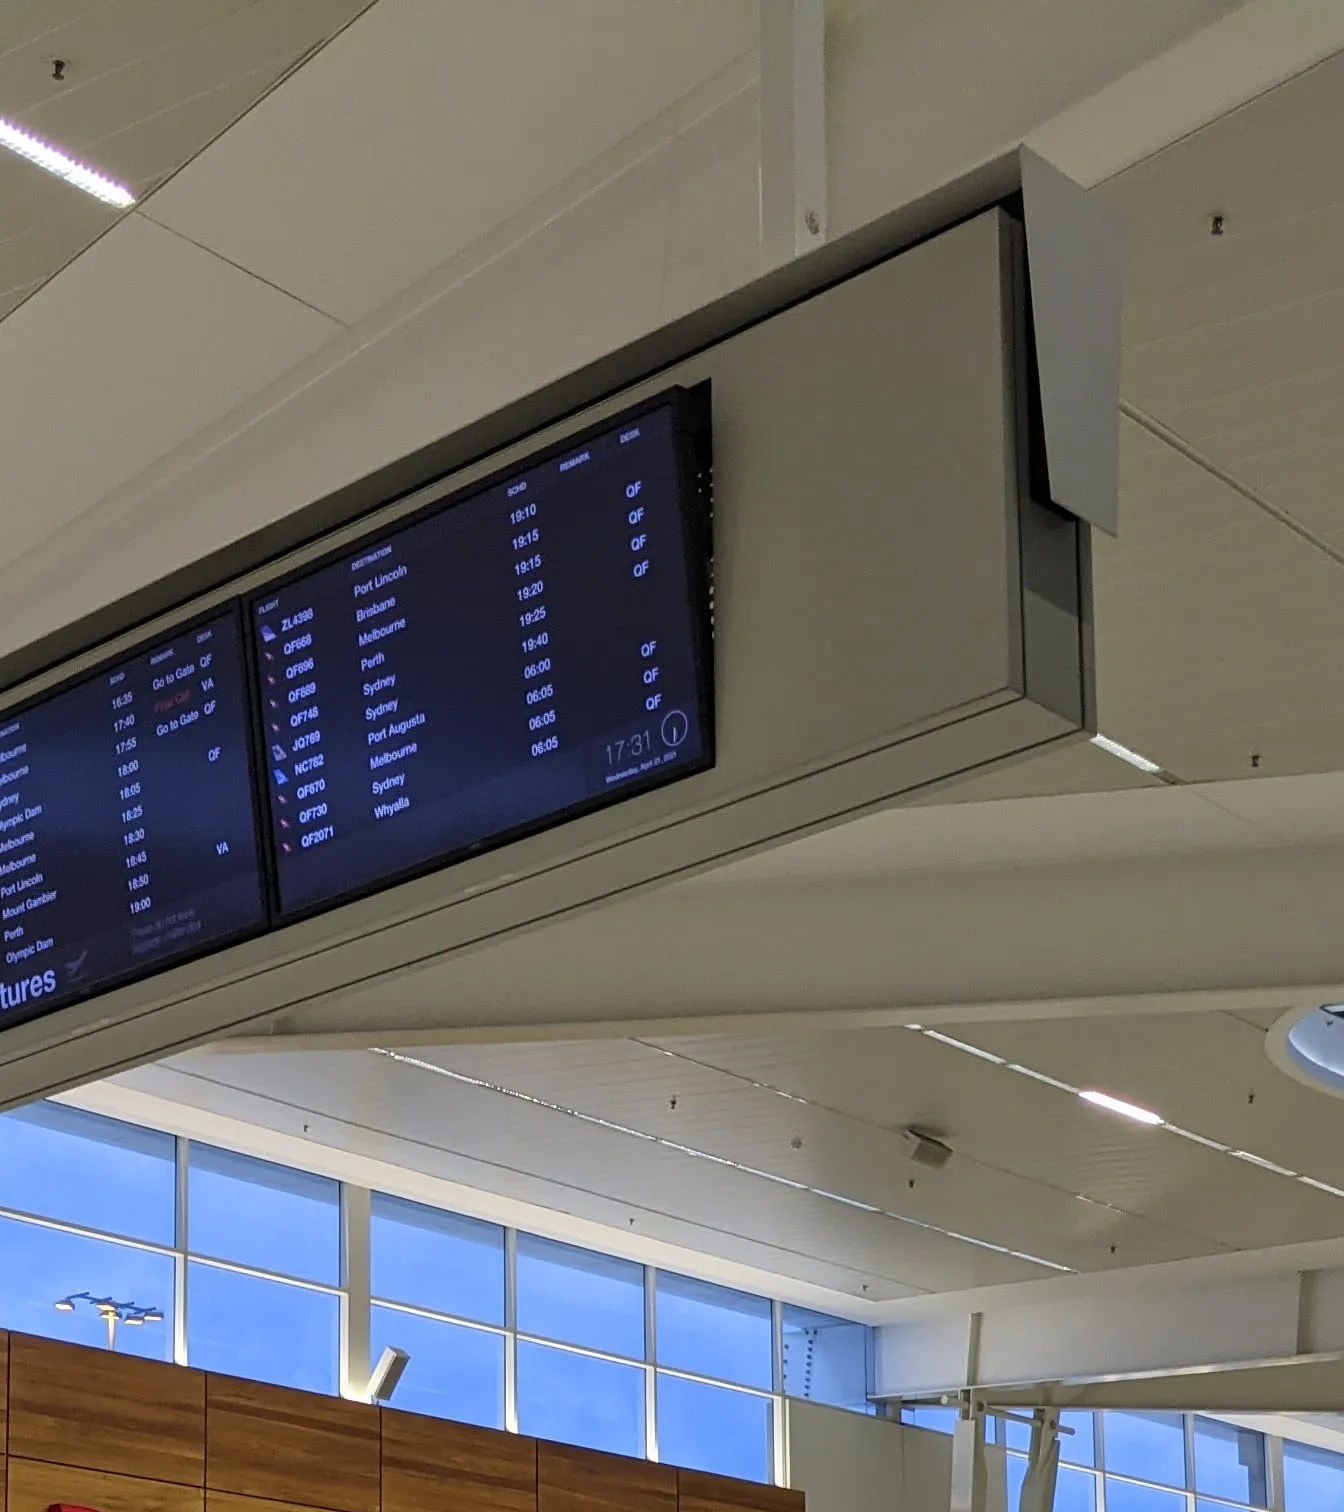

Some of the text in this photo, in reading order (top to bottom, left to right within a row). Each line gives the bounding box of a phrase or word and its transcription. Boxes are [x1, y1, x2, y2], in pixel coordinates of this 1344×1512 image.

[354, 503, 537, 598] Port Lincoln 19:10
[356, 480, 642, 622] Brisbane 19:15 QF
[359, 554, 542, 647] Melbourne 19:15
[361, 534, 647, 672] Perth 19:20 QF
[152, 653, 212, 691] Go to Gate QF
[363, 605, 546, 697] Sydney 19:25
[365, 632, 549, 721] Sydney 19:40
[294, 658, 551, 776] NC782 Port Augusta 06:00
[370, 640, 657, 770] Melbourne 06:05 QF
[606, 730, 651, 765] 17:31
[25, 805, 43, 820] Dam
[299, 773, 405, 824] QF730 Sydney
[301, 693, 662, 848] QF2071 Whyalla QF
[0, 873, 44, 899] Port Lincoln
[2, 902, 26, 920] Mount
